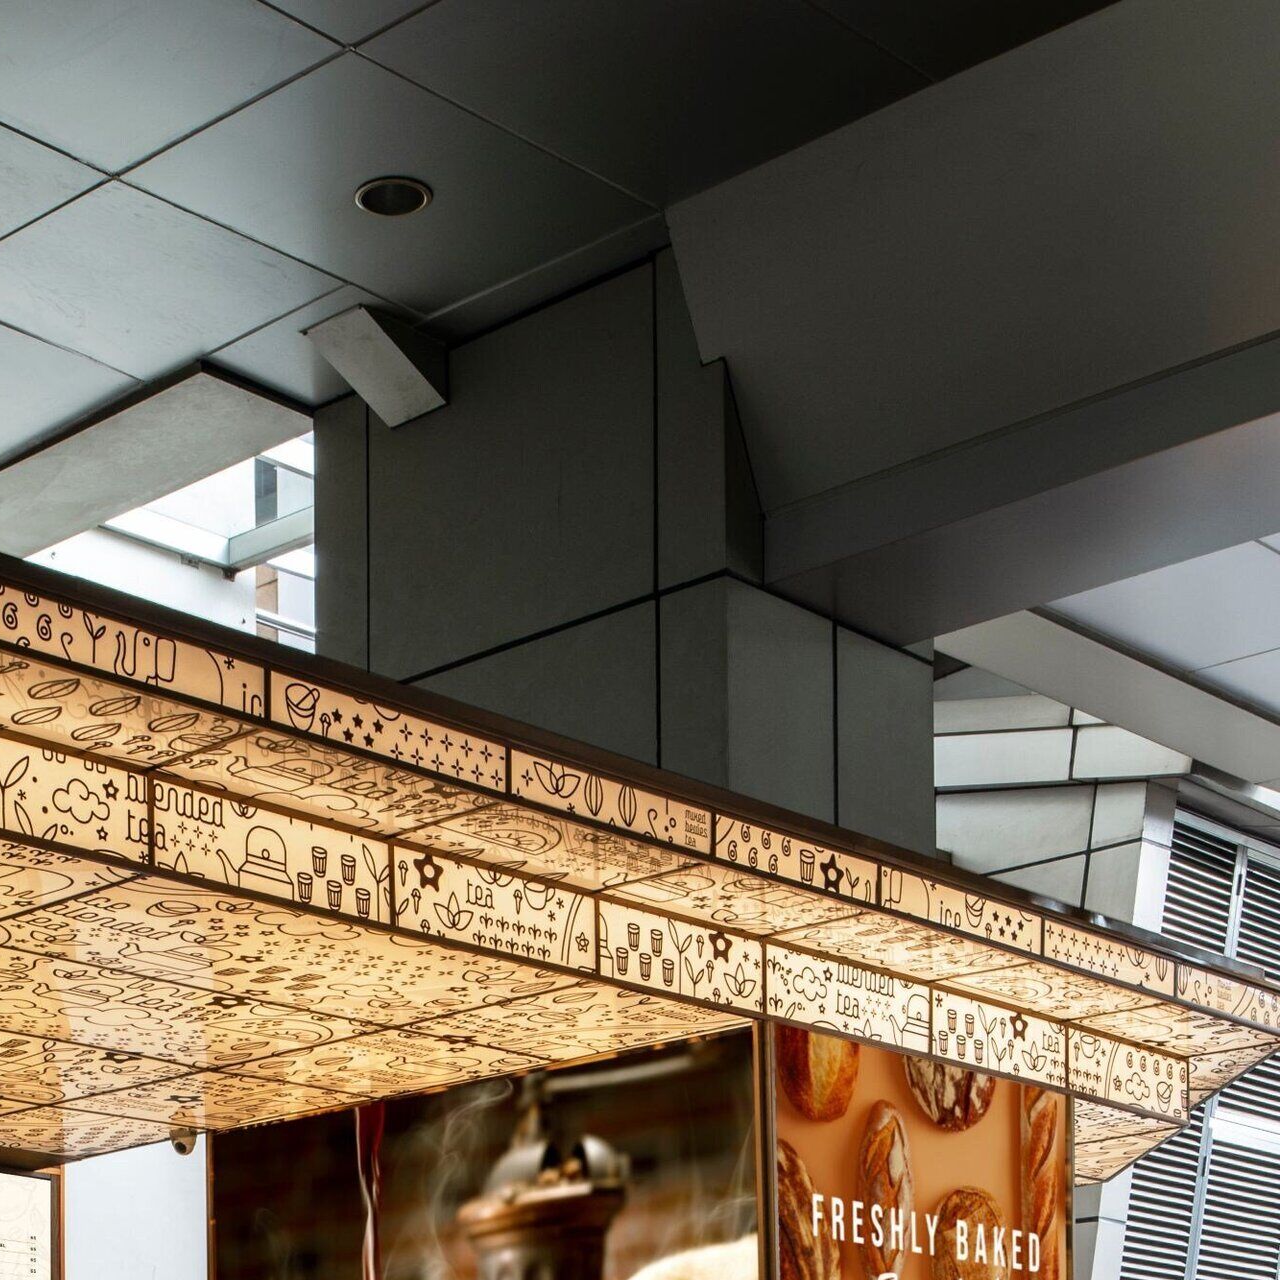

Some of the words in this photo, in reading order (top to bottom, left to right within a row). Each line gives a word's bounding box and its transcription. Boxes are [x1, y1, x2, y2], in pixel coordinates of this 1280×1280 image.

[465, 878, 495, 910] tea
[835, 989, 860, 1020] tea
[1041, 1030, 1061, 1054] tea
[811, 1192, 938, 1257] FRESHLY
[955, 1218, 1041, 1273] BAKED
